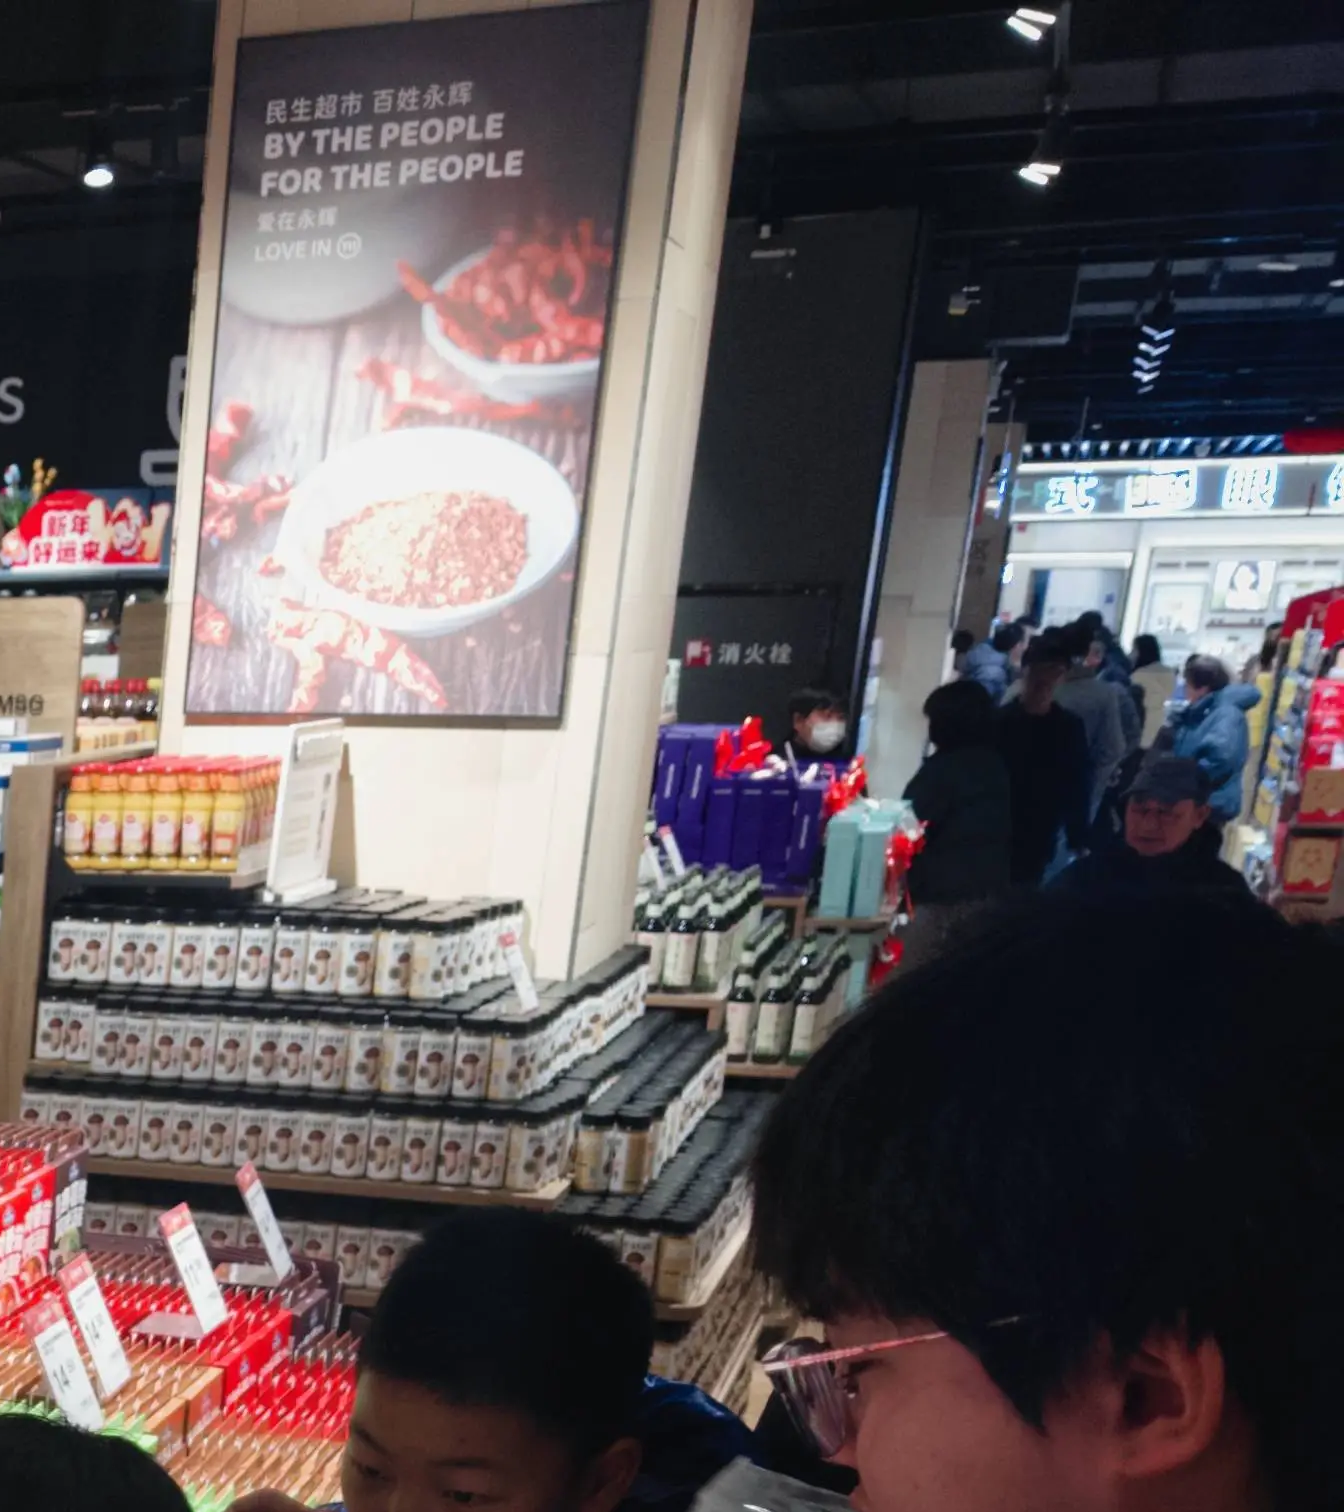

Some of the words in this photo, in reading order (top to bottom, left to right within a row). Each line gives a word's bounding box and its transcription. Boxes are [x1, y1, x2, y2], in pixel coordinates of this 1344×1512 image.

[265, 90, 363, 125] 民生超市
[372, 81, 473, 114] 百姓永辉
[264, 131, 305, 159] BY
[312, 125, 373, 155] THE
[379, 113, 504, 148] PEOPLE
[261, 167, 323, 197] FOR
[331, 161, 391, 191] THE
[399, 150, 524, 185] PEOPLE
[254, 240, 307, 262] LOVE
[311, 239, 331, 257] IN
[45, 515, 91, 537] 新年
[32, 540, 105, 564] 好运来
[718, 641, 793, 666] 消火栓
